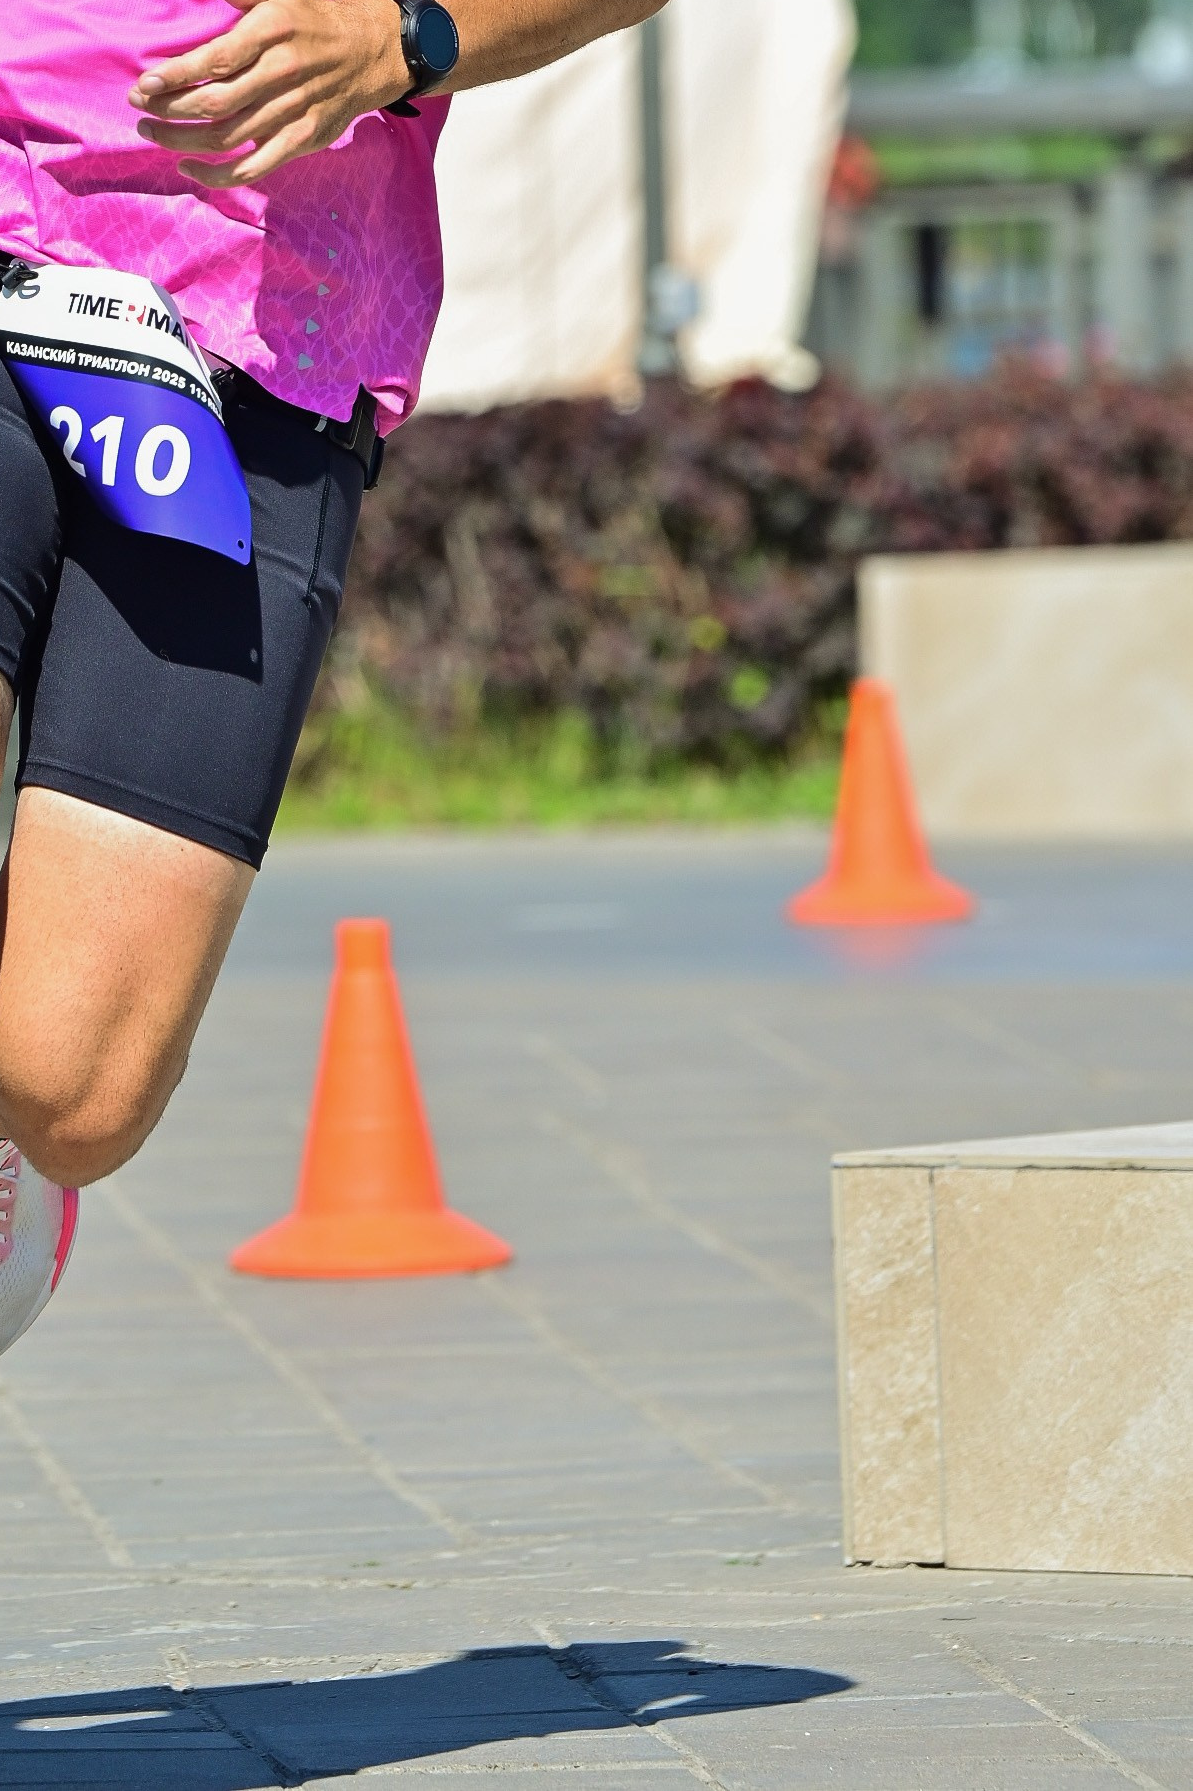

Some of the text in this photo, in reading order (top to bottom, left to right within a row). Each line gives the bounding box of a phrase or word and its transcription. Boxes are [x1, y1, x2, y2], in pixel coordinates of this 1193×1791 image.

[6, 340, 76, 365] КАЗАНСКИЙ
[77, 352, 152, 378] ТРИАТЛОН
[151, 366, 186, 389] 2025
[49, 405, 191, 497] 210
